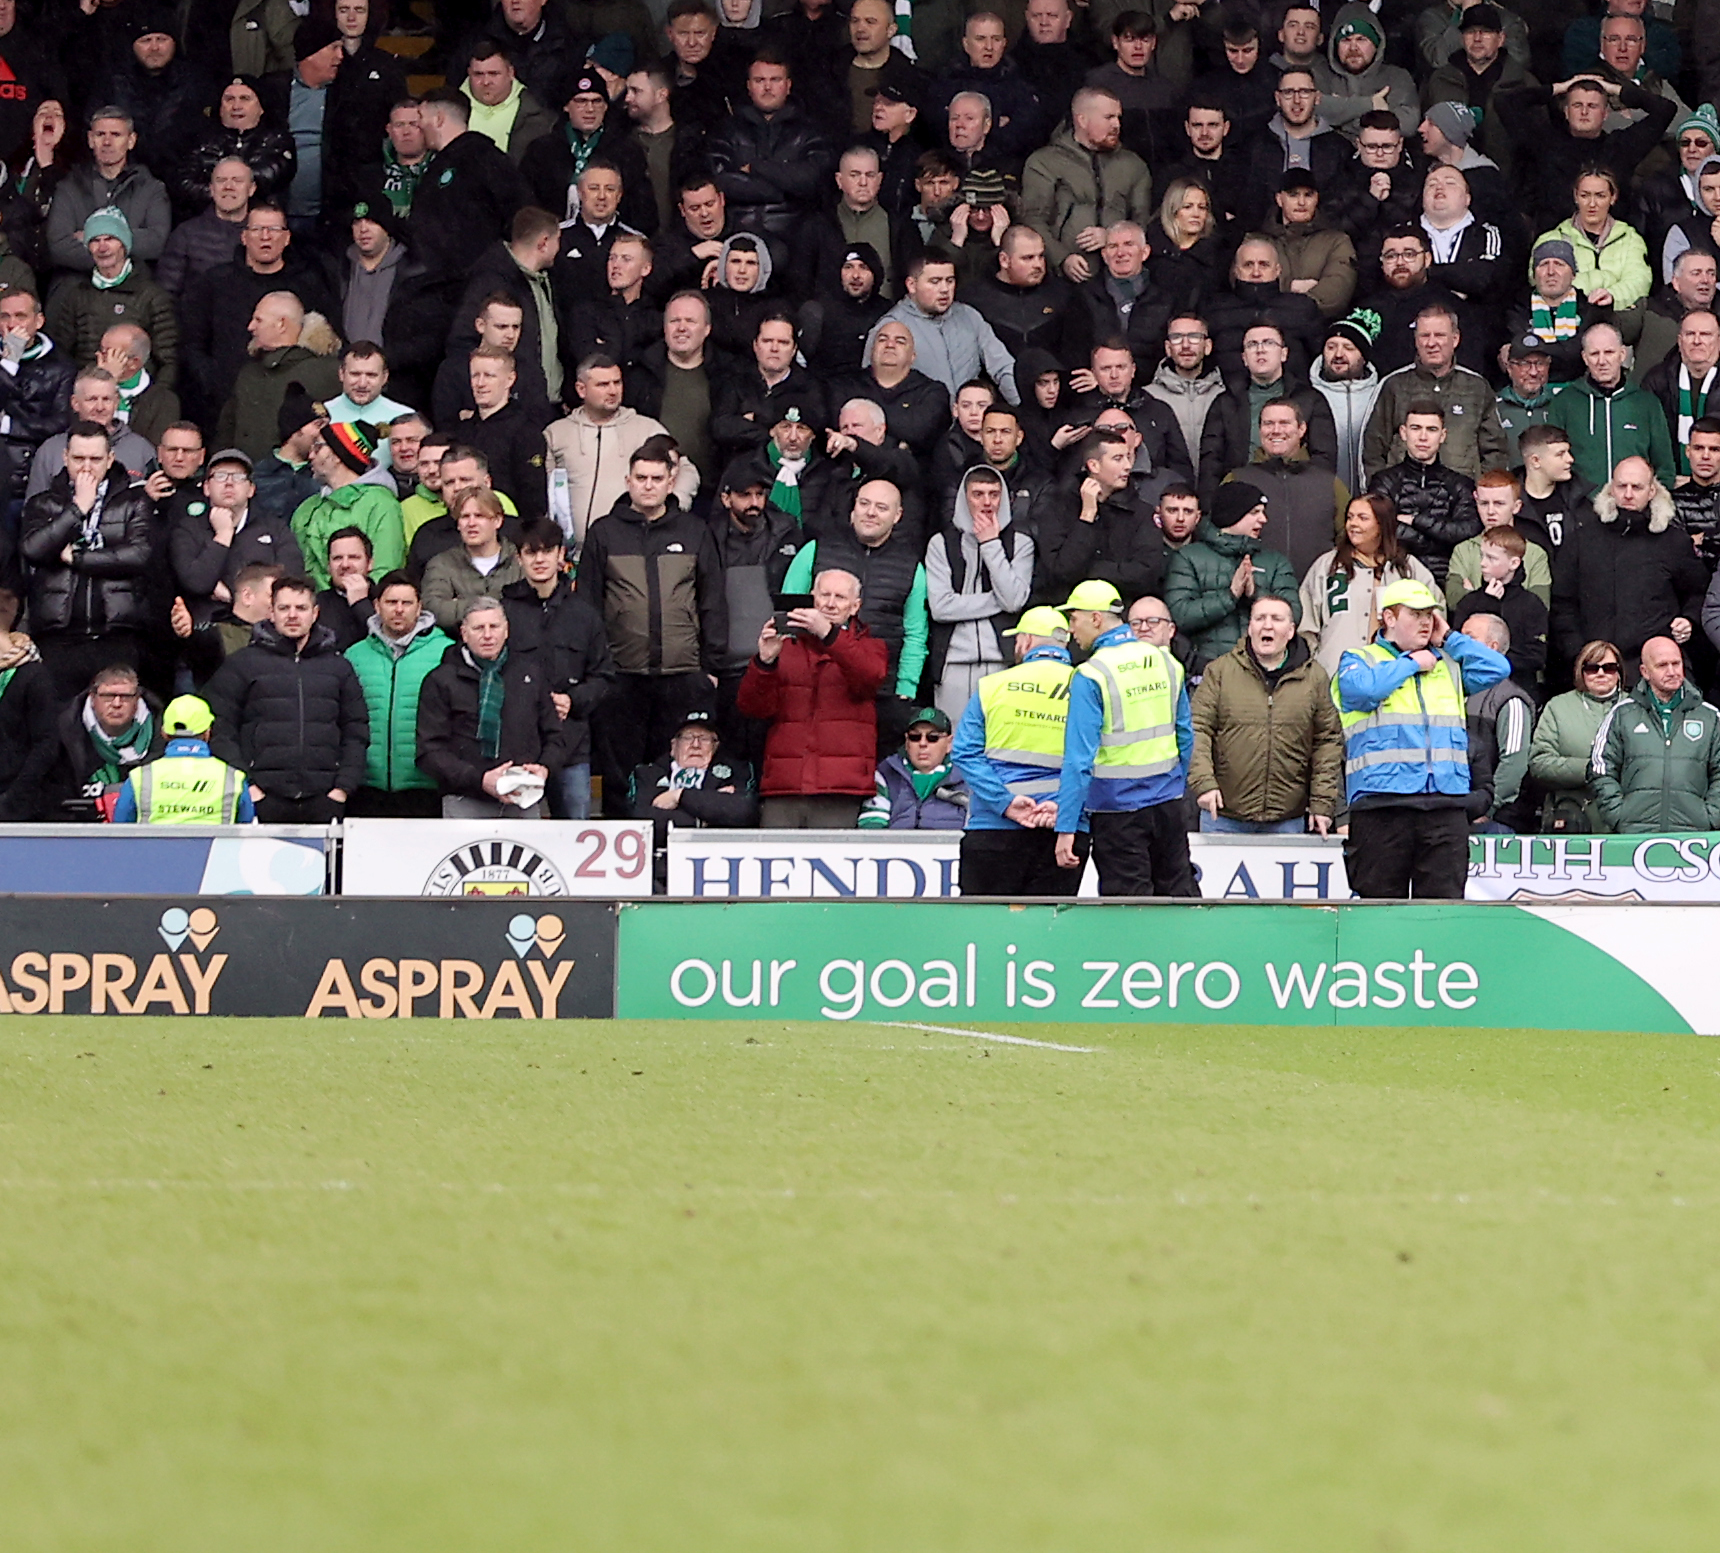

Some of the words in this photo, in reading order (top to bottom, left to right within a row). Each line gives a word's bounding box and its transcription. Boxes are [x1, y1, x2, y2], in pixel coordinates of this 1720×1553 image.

[1328, 575, 1349, 615] 2
[1118, 660, 1142, 673] SGL
[1007, 681, 1047, 695] SGL
[1125, 681, 1168, 698] STEWARD
[160, 781, 189, 790] SGL
[158, 804, 214, 814] STEWARD
[574, 829, 646, 879] 29
[481, 869, 510, 880] 1877
[306, 959, 576, 1019] ASPRAY
[668, 958, 797, 1009] our
[820, 942, 977, 1022] goal
[1005, 944, 1056, 1010] is
[1082, 960, 1241, 1010] zero
[1264, 949, 1480, 1011] waste
